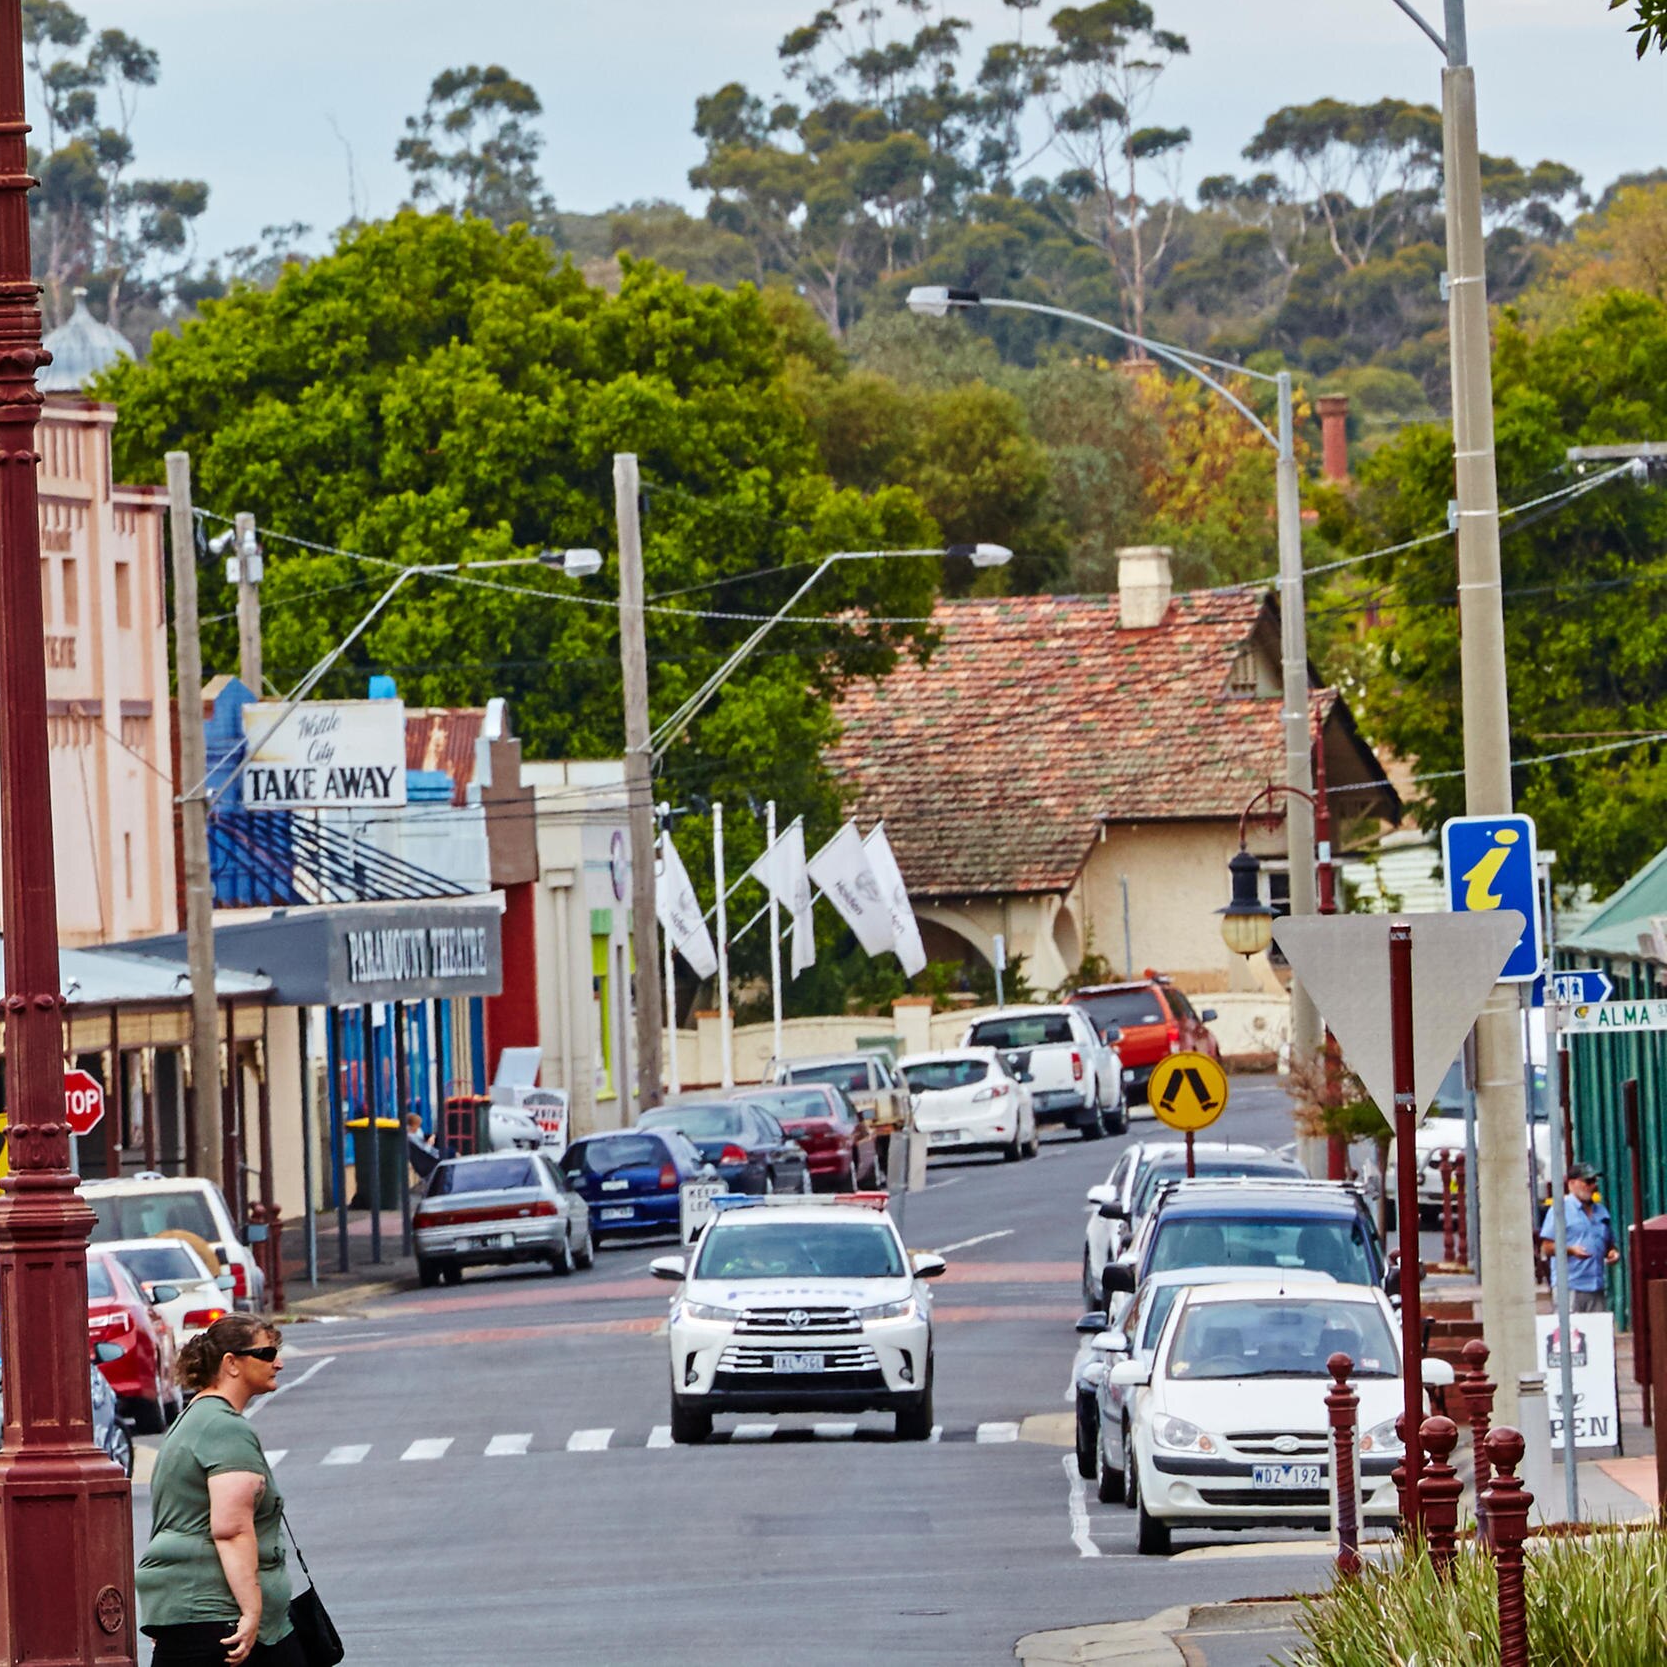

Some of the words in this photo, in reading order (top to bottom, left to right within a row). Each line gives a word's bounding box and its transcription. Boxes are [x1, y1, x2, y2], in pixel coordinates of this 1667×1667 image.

[246, 767, 318, 802] TAKE
[323, 765, 397, 800] AWAY
[1598, 1005, 1651, 1027] ALMA
[65, 1089, 99, 1115] TOP
[1549, 1416, 1609, 1439] PEN
[1255, 1468, 1281, 1484] WDZ
[1294, 1468, 1318, 1484] 192
